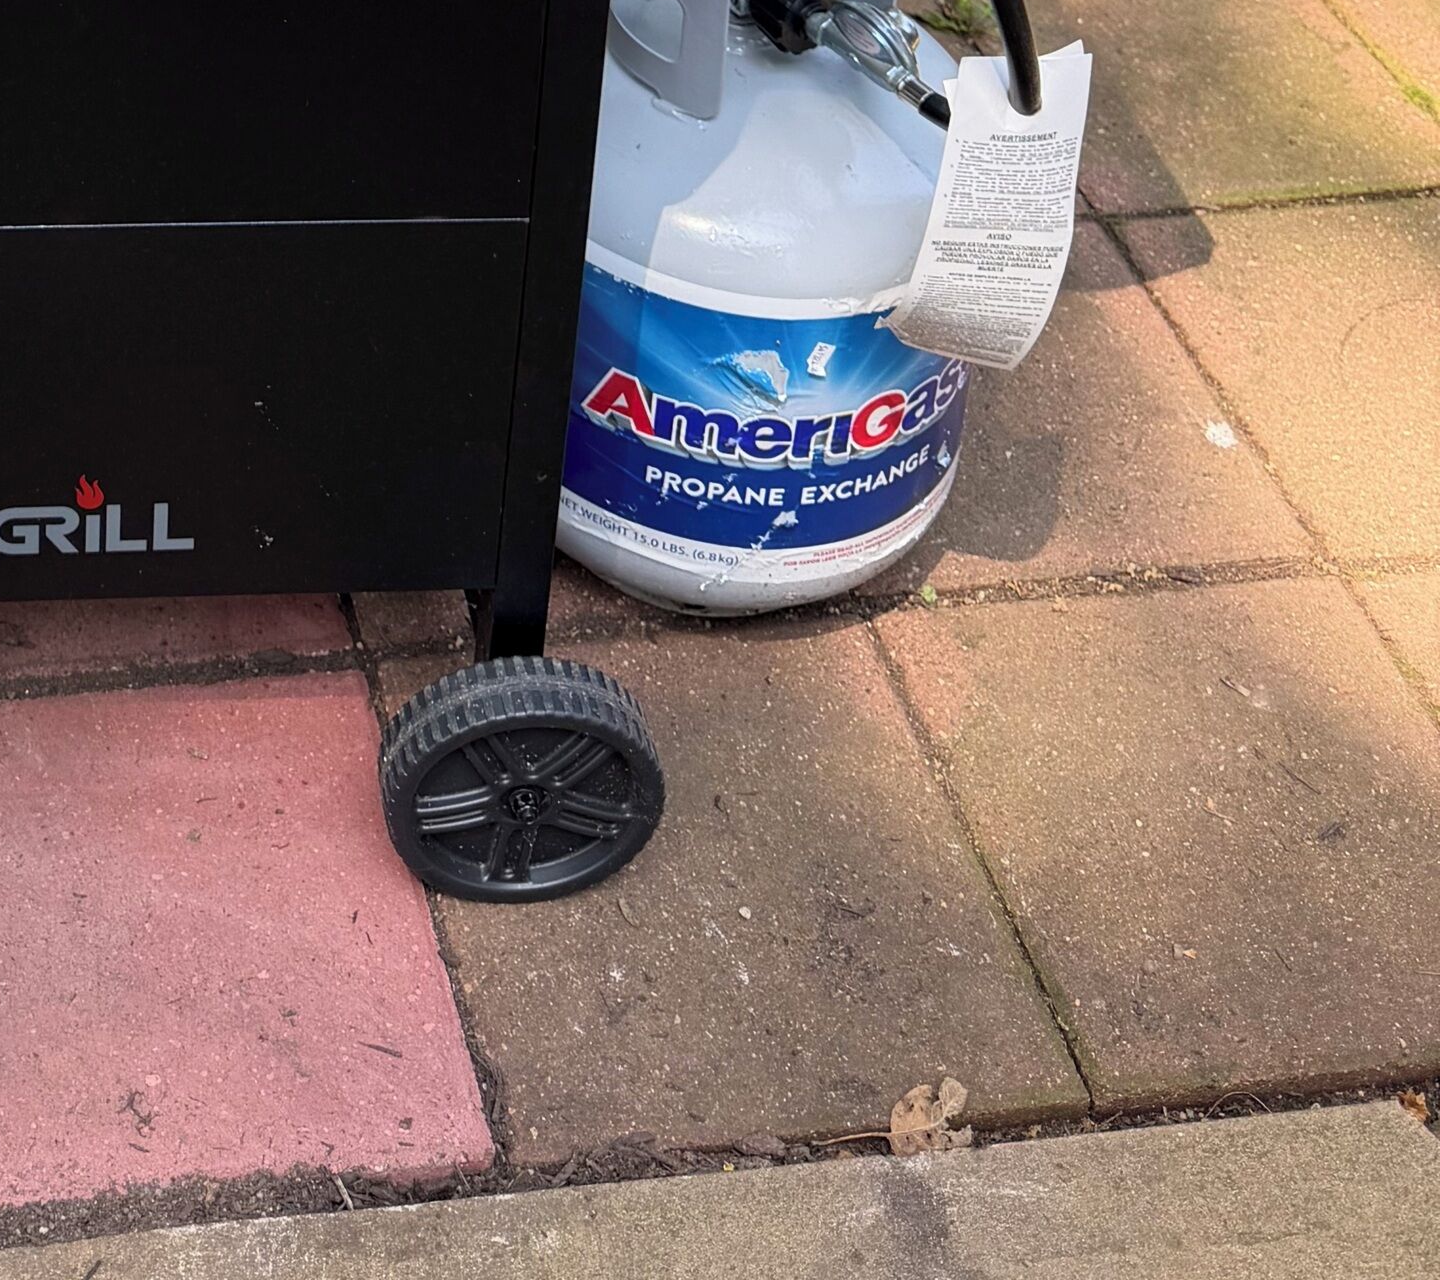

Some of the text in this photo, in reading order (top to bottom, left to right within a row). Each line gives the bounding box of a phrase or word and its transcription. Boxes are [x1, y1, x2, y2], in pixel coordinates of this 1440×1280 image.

[990, 131, 1058, 142] AVERTISSEMENT
[986, 233, 1012, 241] AVISO
[582, 360, 961, 463] AmeriGas
[645, 444, 930, 507] PROPANE EXCHANGE
[581, 507, 633, 538] WEIGHT
[633, 531, 660, 549] 15.0
[662, 542, 690, 557] LBS.
